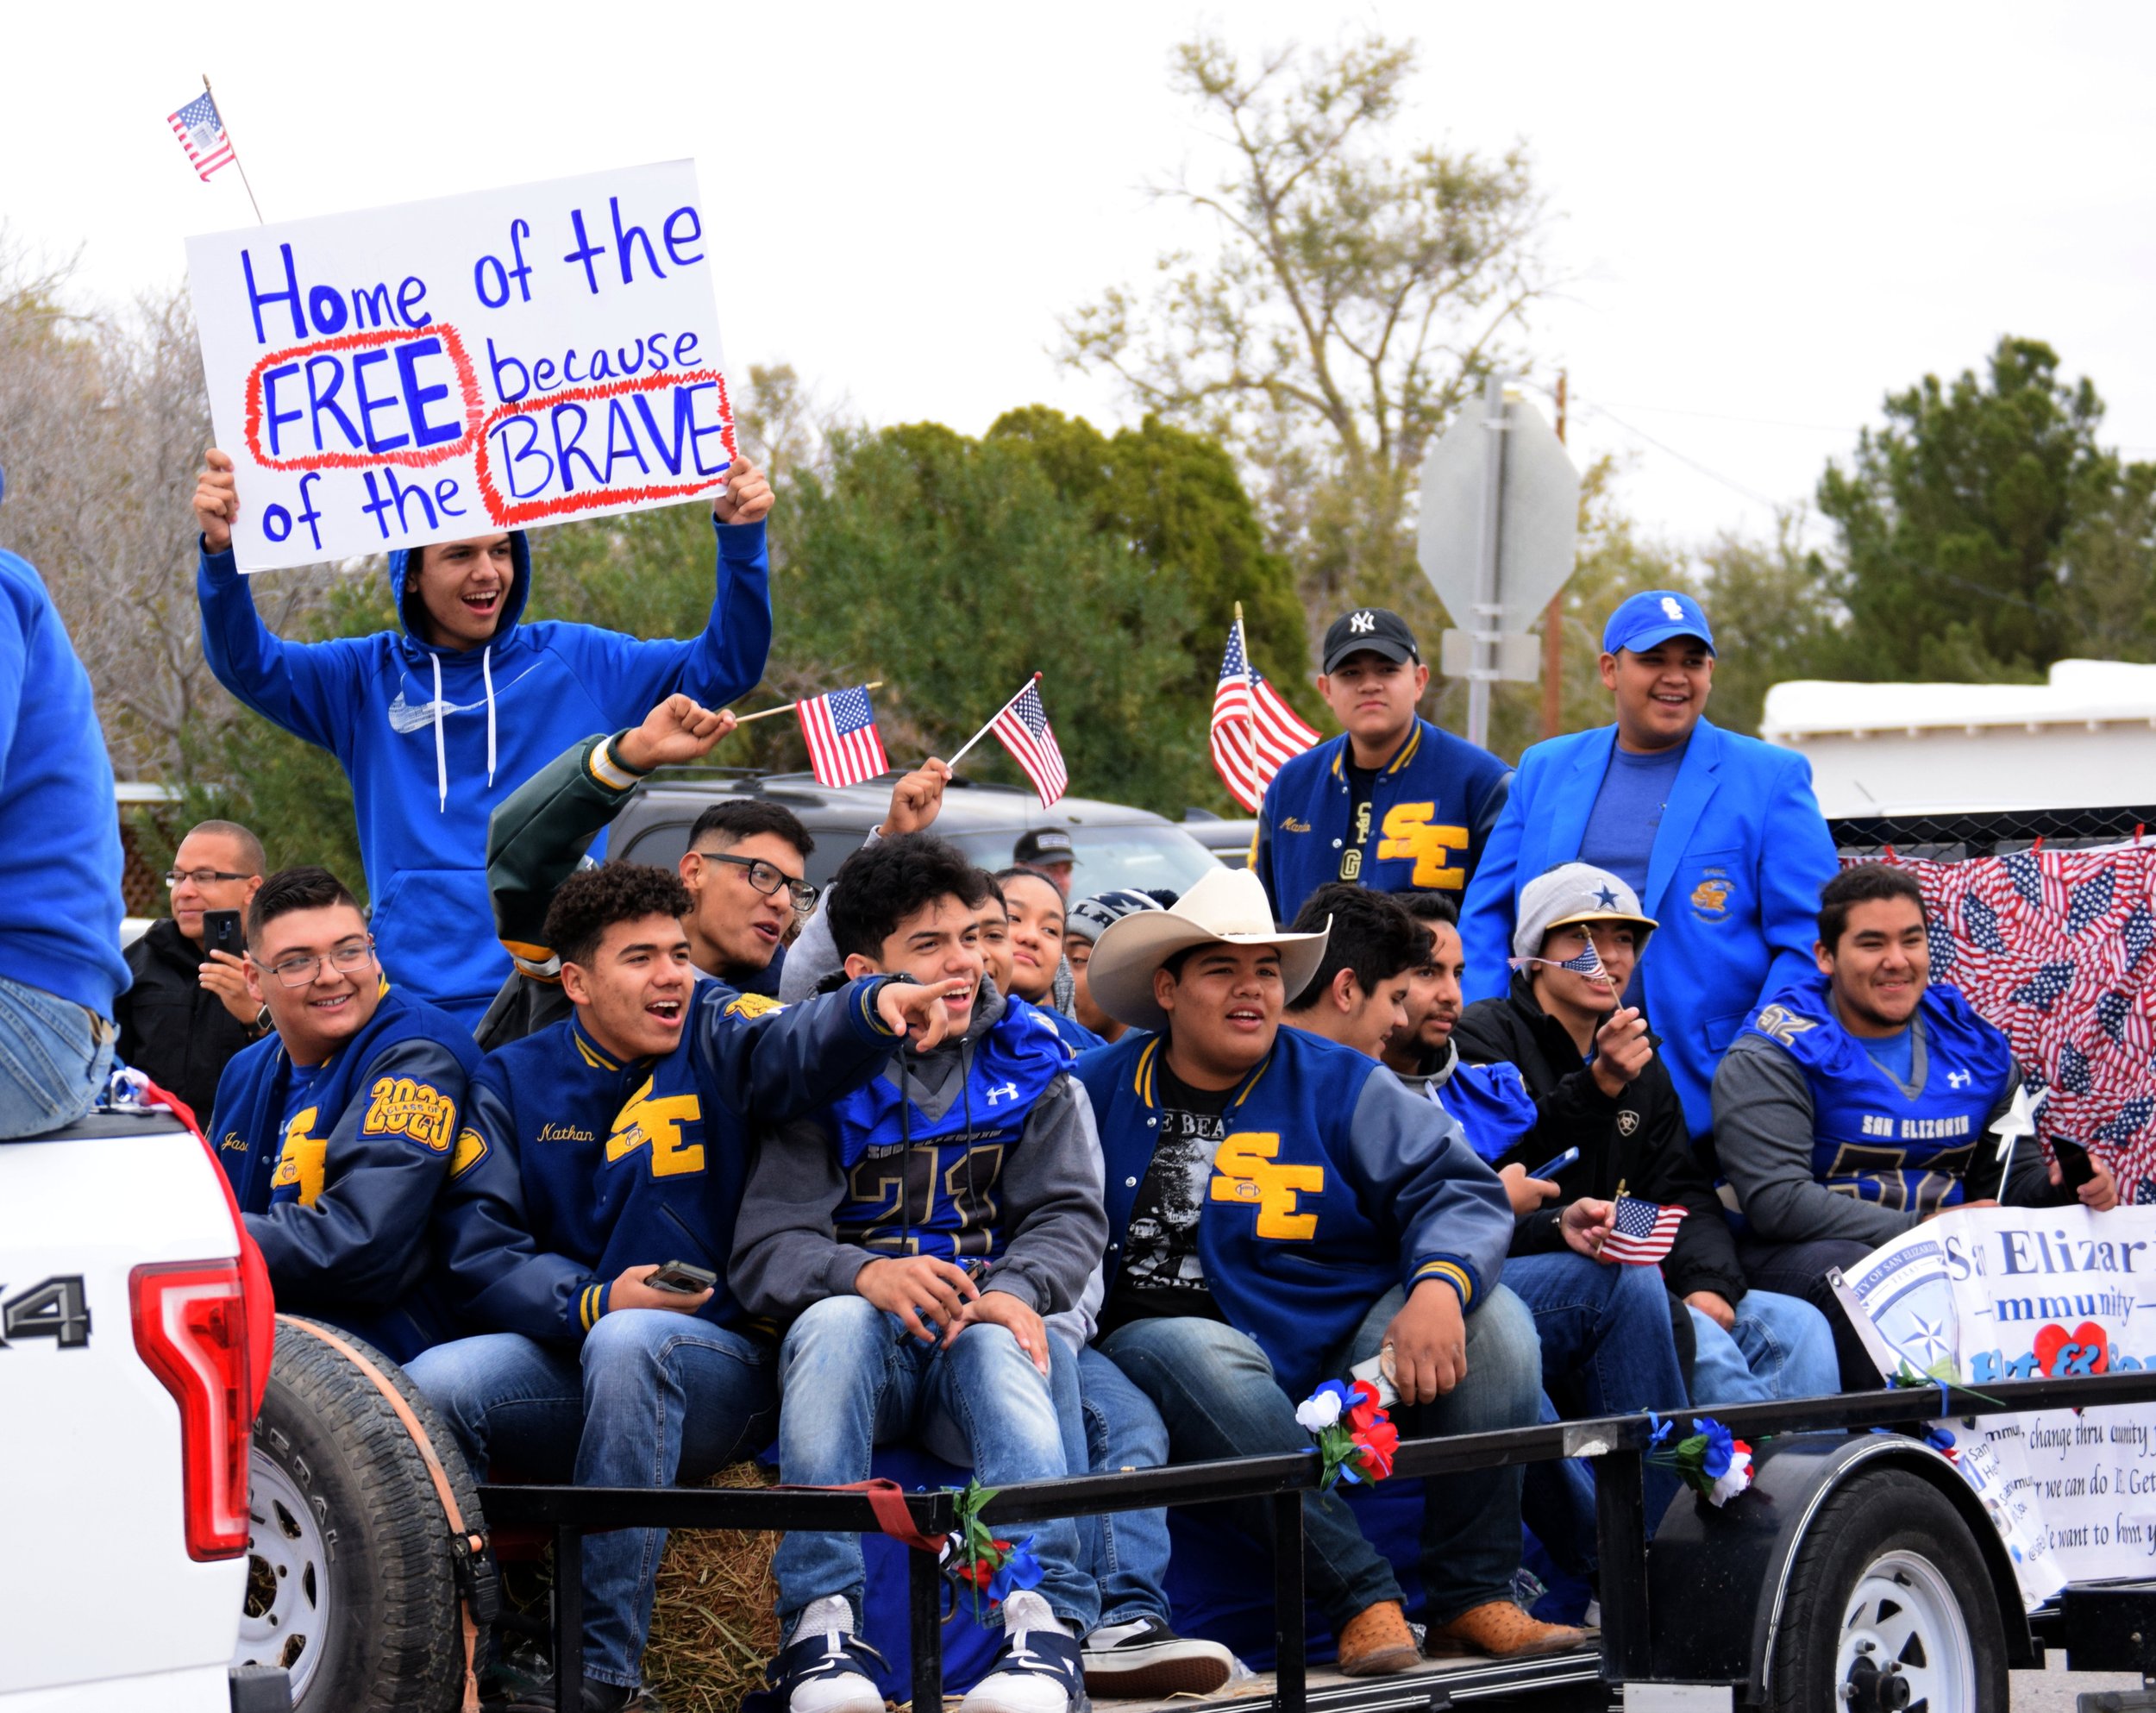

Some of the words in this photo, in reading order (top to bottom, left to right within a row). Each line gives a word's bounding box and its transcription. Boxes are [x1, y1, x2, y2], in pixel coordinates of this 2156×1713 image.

[241, 243, 432, 343] Home
[474, 219, 533, 308] of
[564, 197, 705, 293] the
[262, 337, 462, 455] FREE
[487, 331, 703, 403] because
[262, 472, 323, 549] of
[362, 467, 467, 538] the
[488, 380, 731, 499] BRAVE
[1377, 801, 1470, 889] SE
[363, 1077, 456, 1151] 2020
[386, 1103, 425, 1114] CLASS
[428, 1104, 441, 1114] OF
[1862, 1114, 1894, 1138] SAN
[1902, 1114, 1970, 1139] ELIZARIO
[536, 1122, 595, 1142] Nathan
[1211, 1132, 1324, 1240] SE
[1883, 1254, 1902, 1271] SAN
[1994, 1229, 2156, 1276] Elizar
[2030, 1417, 2071, 1460] change
[2076, 1415, 2103, 1446] thru
[2046, 1478, 2062, 1499] we
[2065, 1477, 2084, 1497] can
[2090, 1463, 2108, 1495] do
[2059, 1523, 2088, 1548] want
[2093, 1522, 2109, 1546] to
